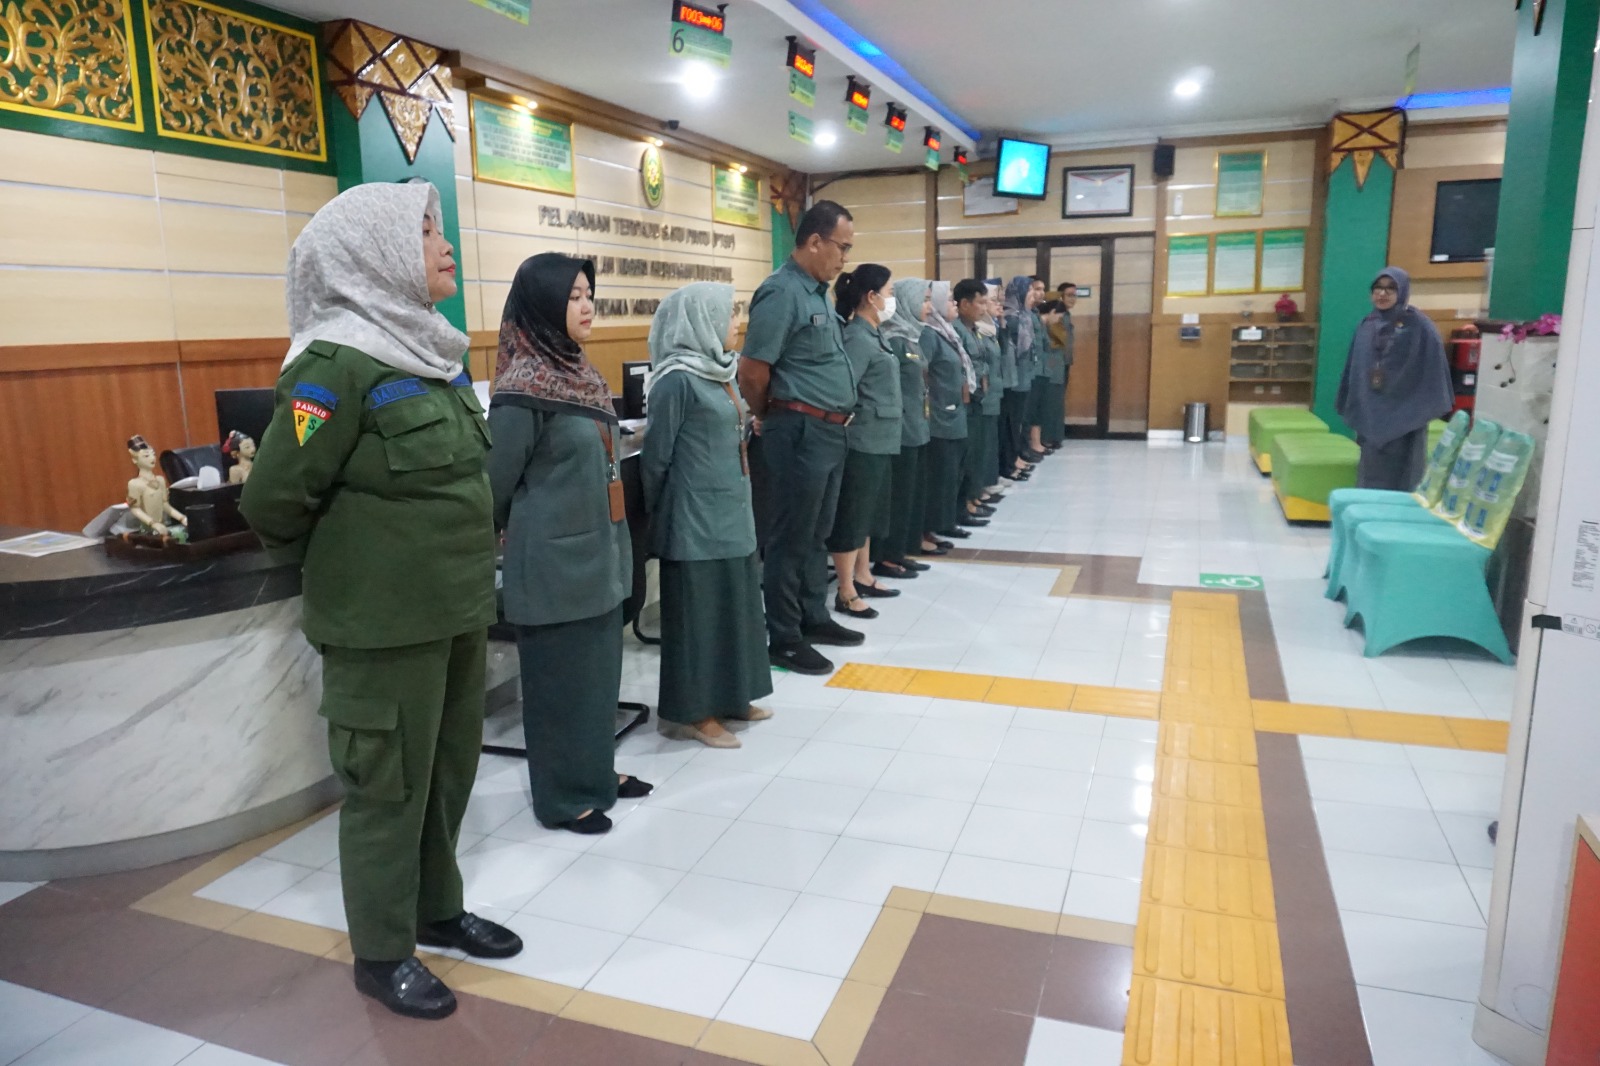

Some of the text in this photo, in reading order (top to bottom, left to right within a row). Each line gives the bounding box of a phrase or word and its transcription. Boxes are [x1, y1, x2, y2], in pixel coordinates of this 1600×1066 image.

[673, 28, 685, 53] 6
[297, 414, 317, 431] P S
